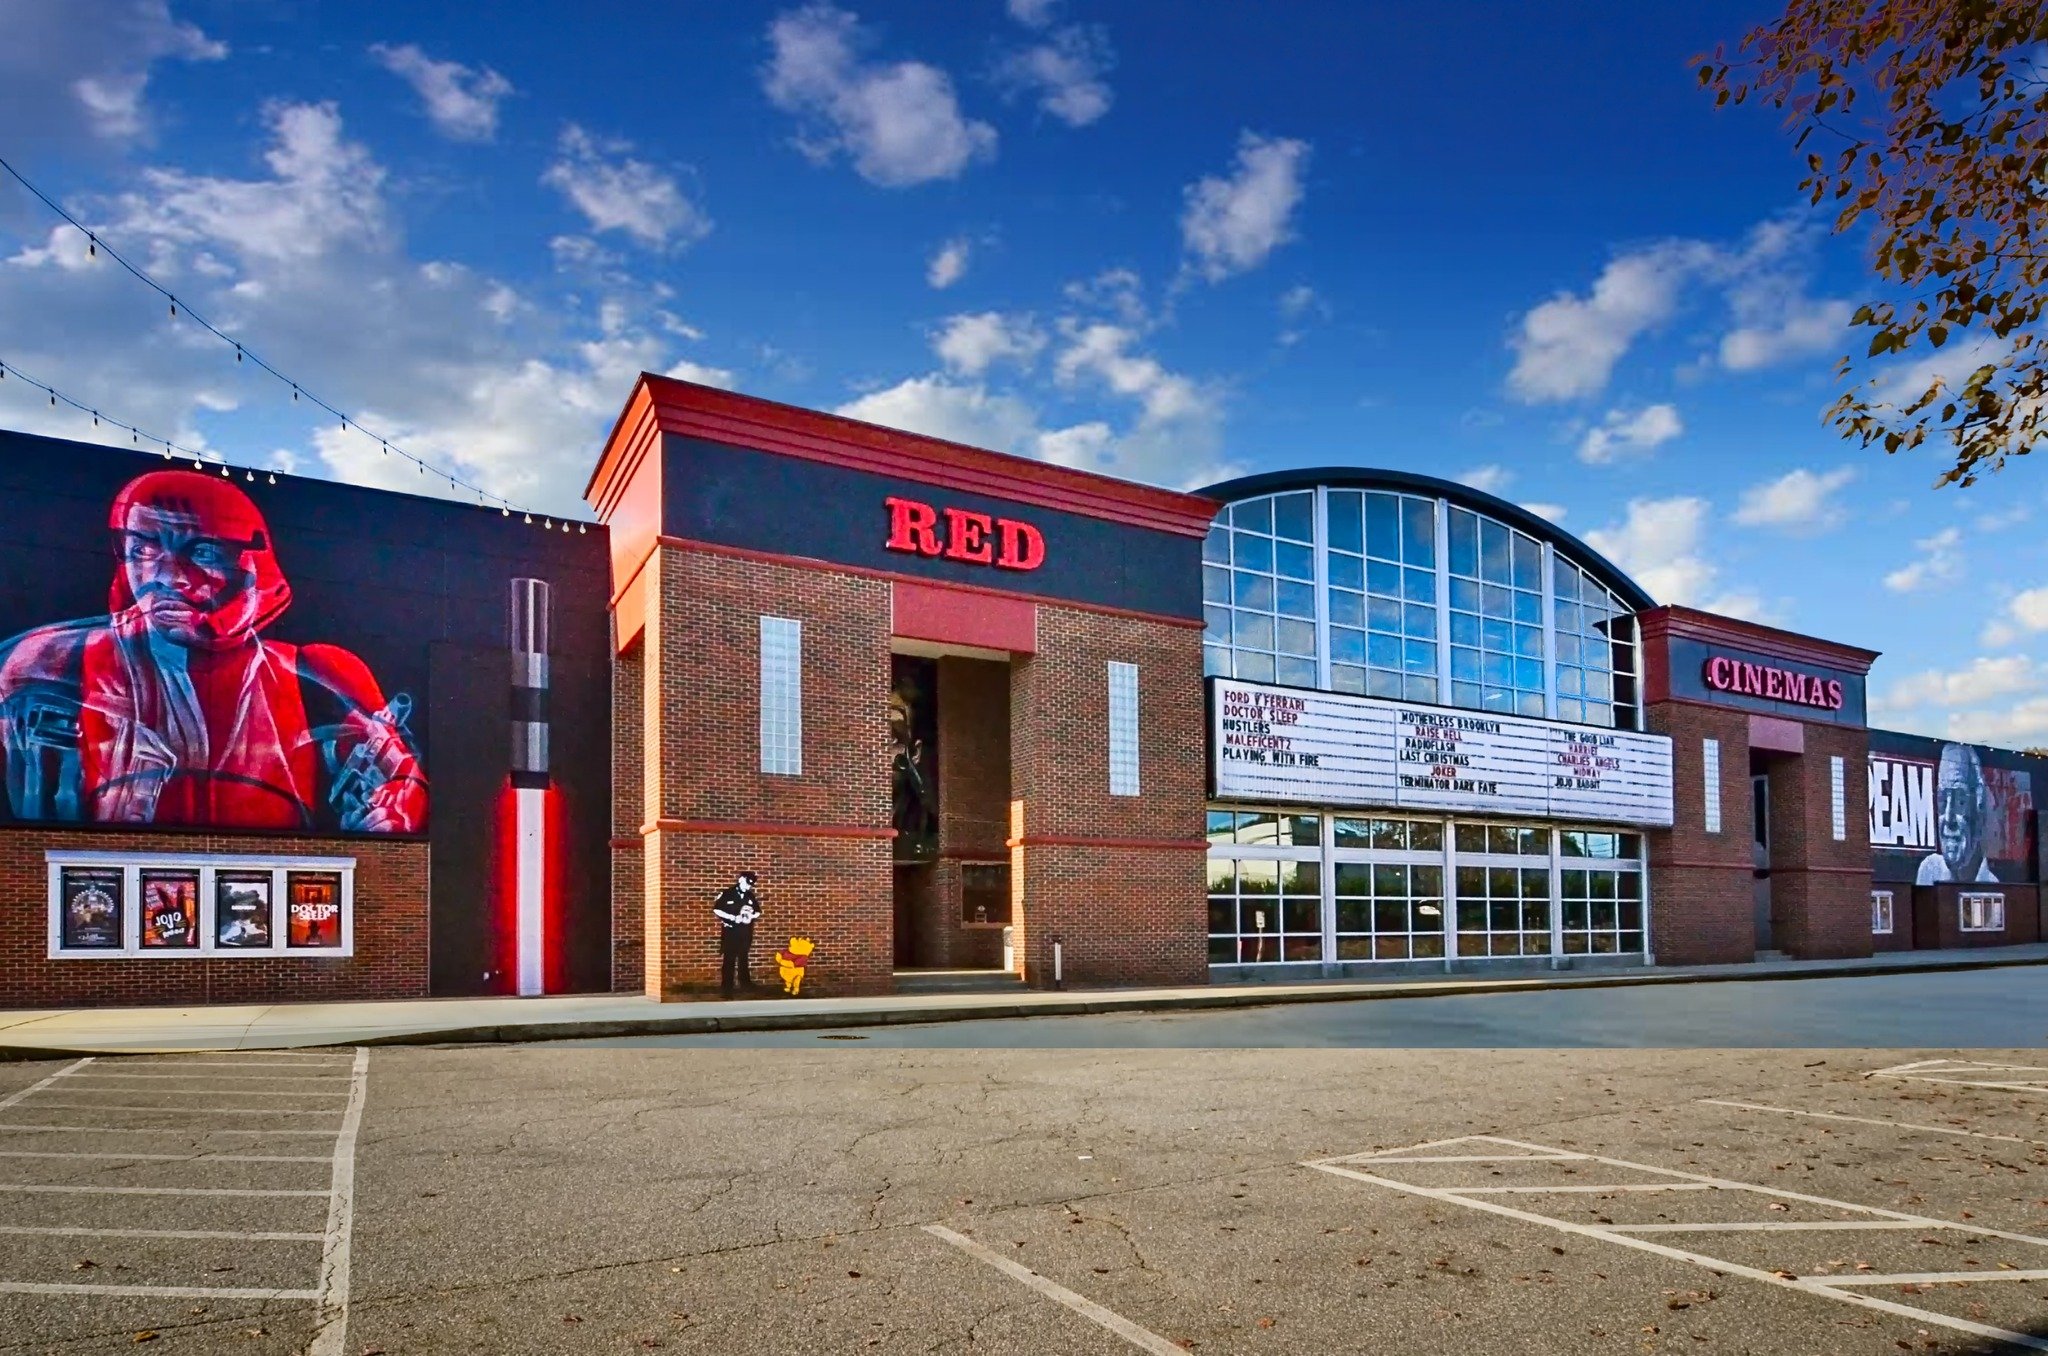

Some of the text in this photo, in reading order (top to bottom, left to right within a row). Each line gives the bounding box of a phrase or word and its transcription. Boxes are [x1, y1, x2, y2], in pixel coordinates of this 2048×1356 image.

[886, 496, 1046, 571] RED
[1708, 656, 1843, 709] CINEMAS
[1224, 691, 1305, 711] FORD V FERRARI
[1224, 705, 1298, 724] DOCTOR SLEEP
[1401, 712, 1501, 733] MOTHERLESS BROOKLYN
[1222, 719, 1270, 734] HUSTLERS
[1415, 726, 1462, 741] RAISE HELL
[1405, 738, 1456, 752] RADIOFLASH
[1564, 731, 1576, 742] THE
[1223, 747, 1319, 766] PLAYING WITH FIRE
[1400, 749, 1470, 766] LAST CHRISTMAS
[1430, 765, 1456, 777] JOKER
[1399, 776, 1497, 794] TERMINATOR DARK FATE
[1555, 776, 1573, 788] JOJO
[291, 904, 338, 913] DOCTOR
[155, 911, 182, 929] JOJO
